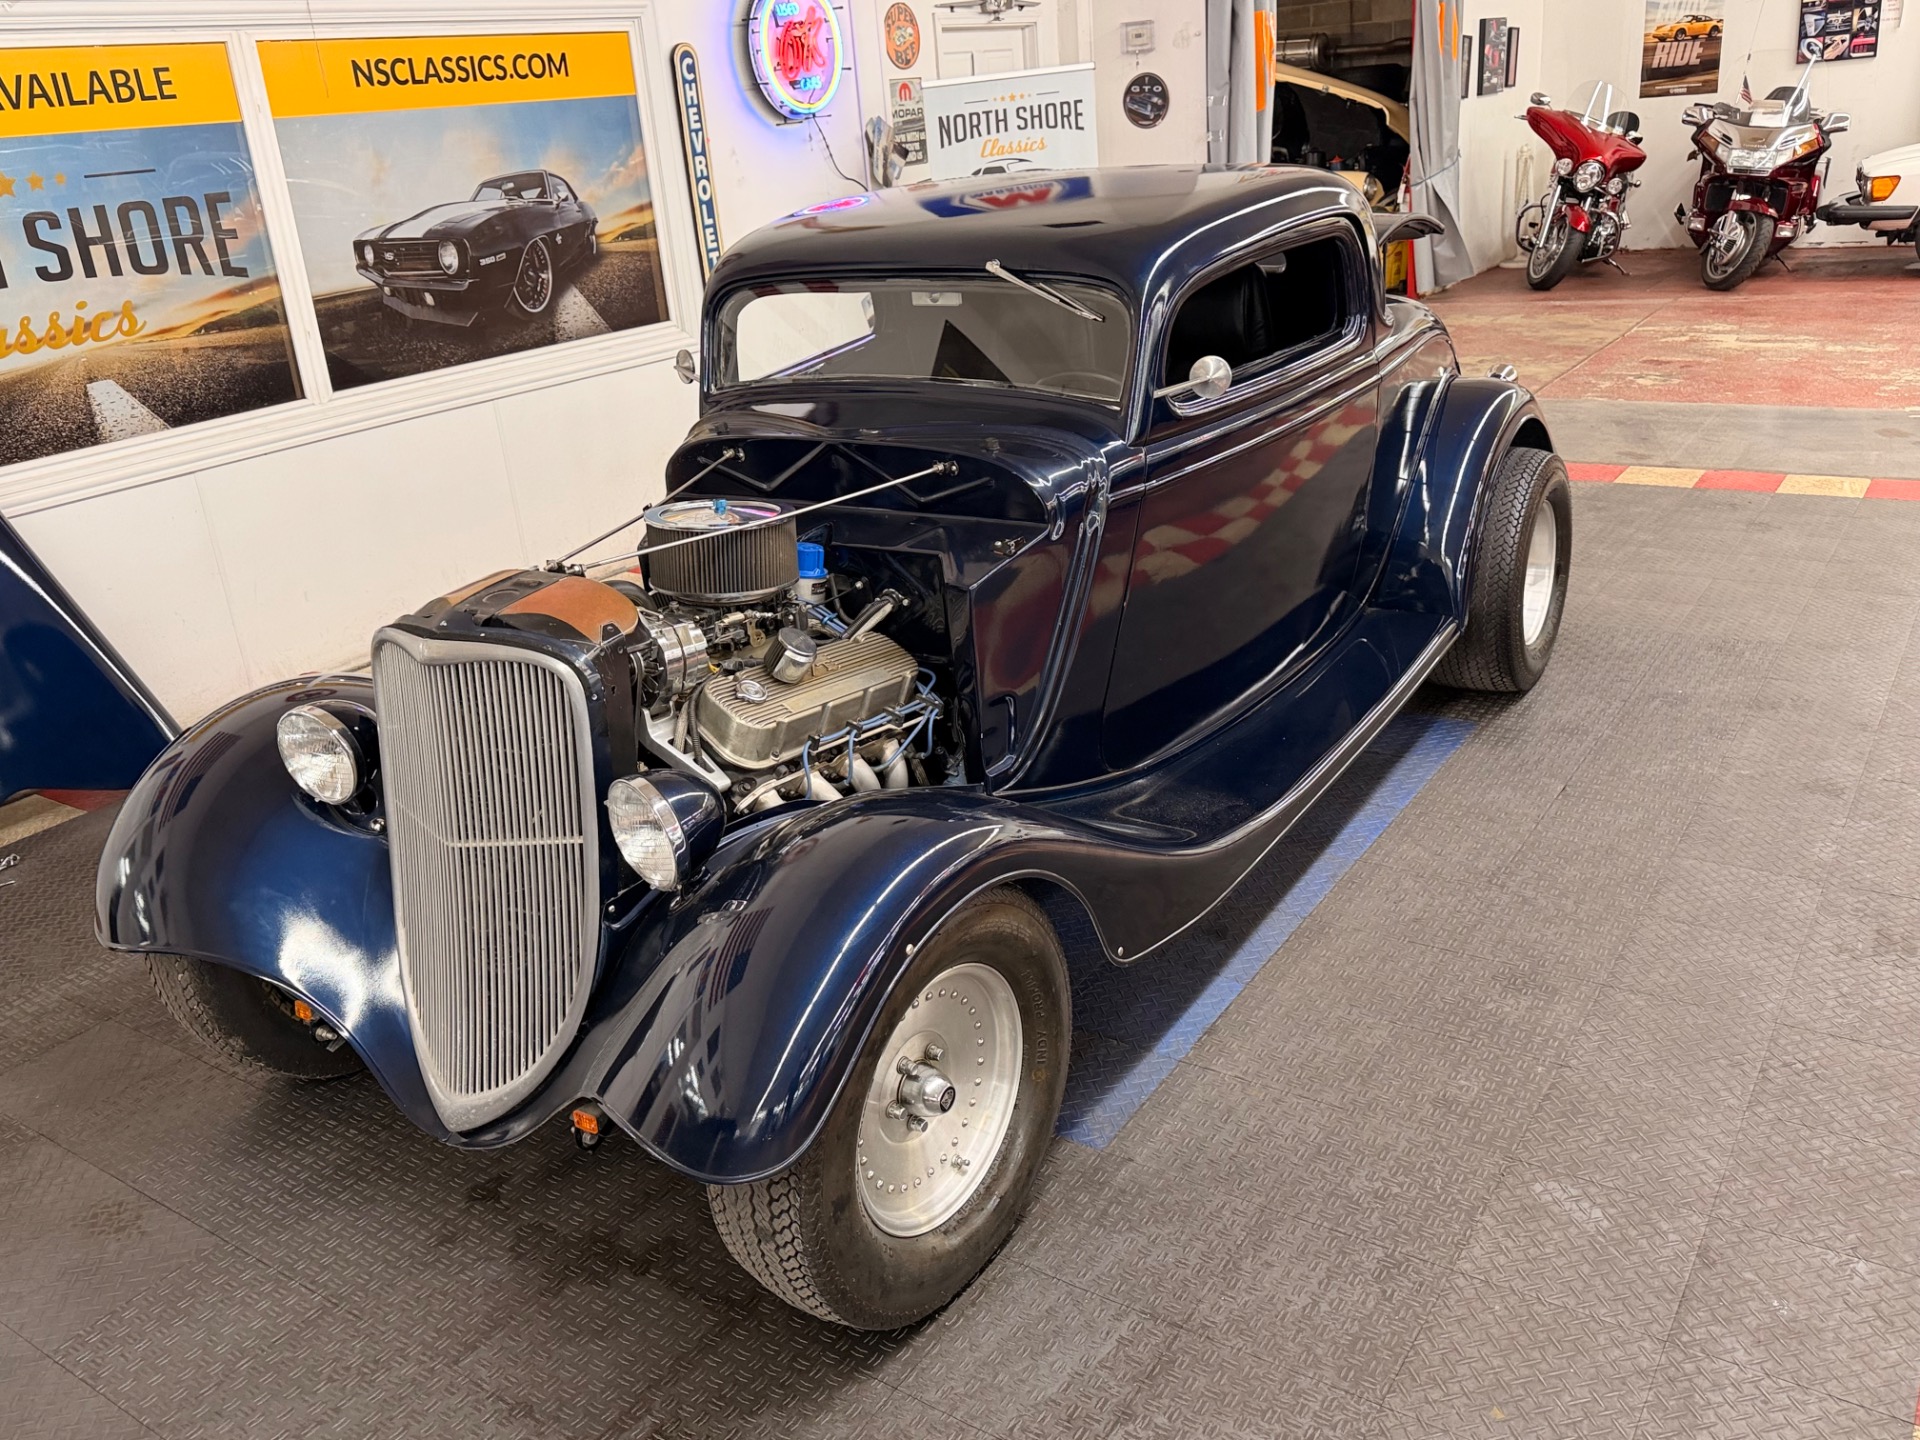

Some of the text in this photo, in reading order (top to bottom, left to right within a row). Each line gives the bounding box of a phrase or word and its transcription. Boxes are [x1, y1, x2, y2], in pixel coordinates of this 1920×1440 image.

[886, 5, 916, 41] SUPER
[351, 52, 570, 88] NSCLASSICS.COM
[894, 41, 916, 67] BEE
[1651, 39, 1706, 69] RIDE
[1130, 85, 1163, 93] GTO
[938, 99, 1085, 149] NORTH SHORE
[681, 57, 722, 269] CHEVROLET
[980, 136, 1048, 158] Classics
[22, 191, 250, 283] SHORE
[1036, 1031, 1048, 1065] INDY
